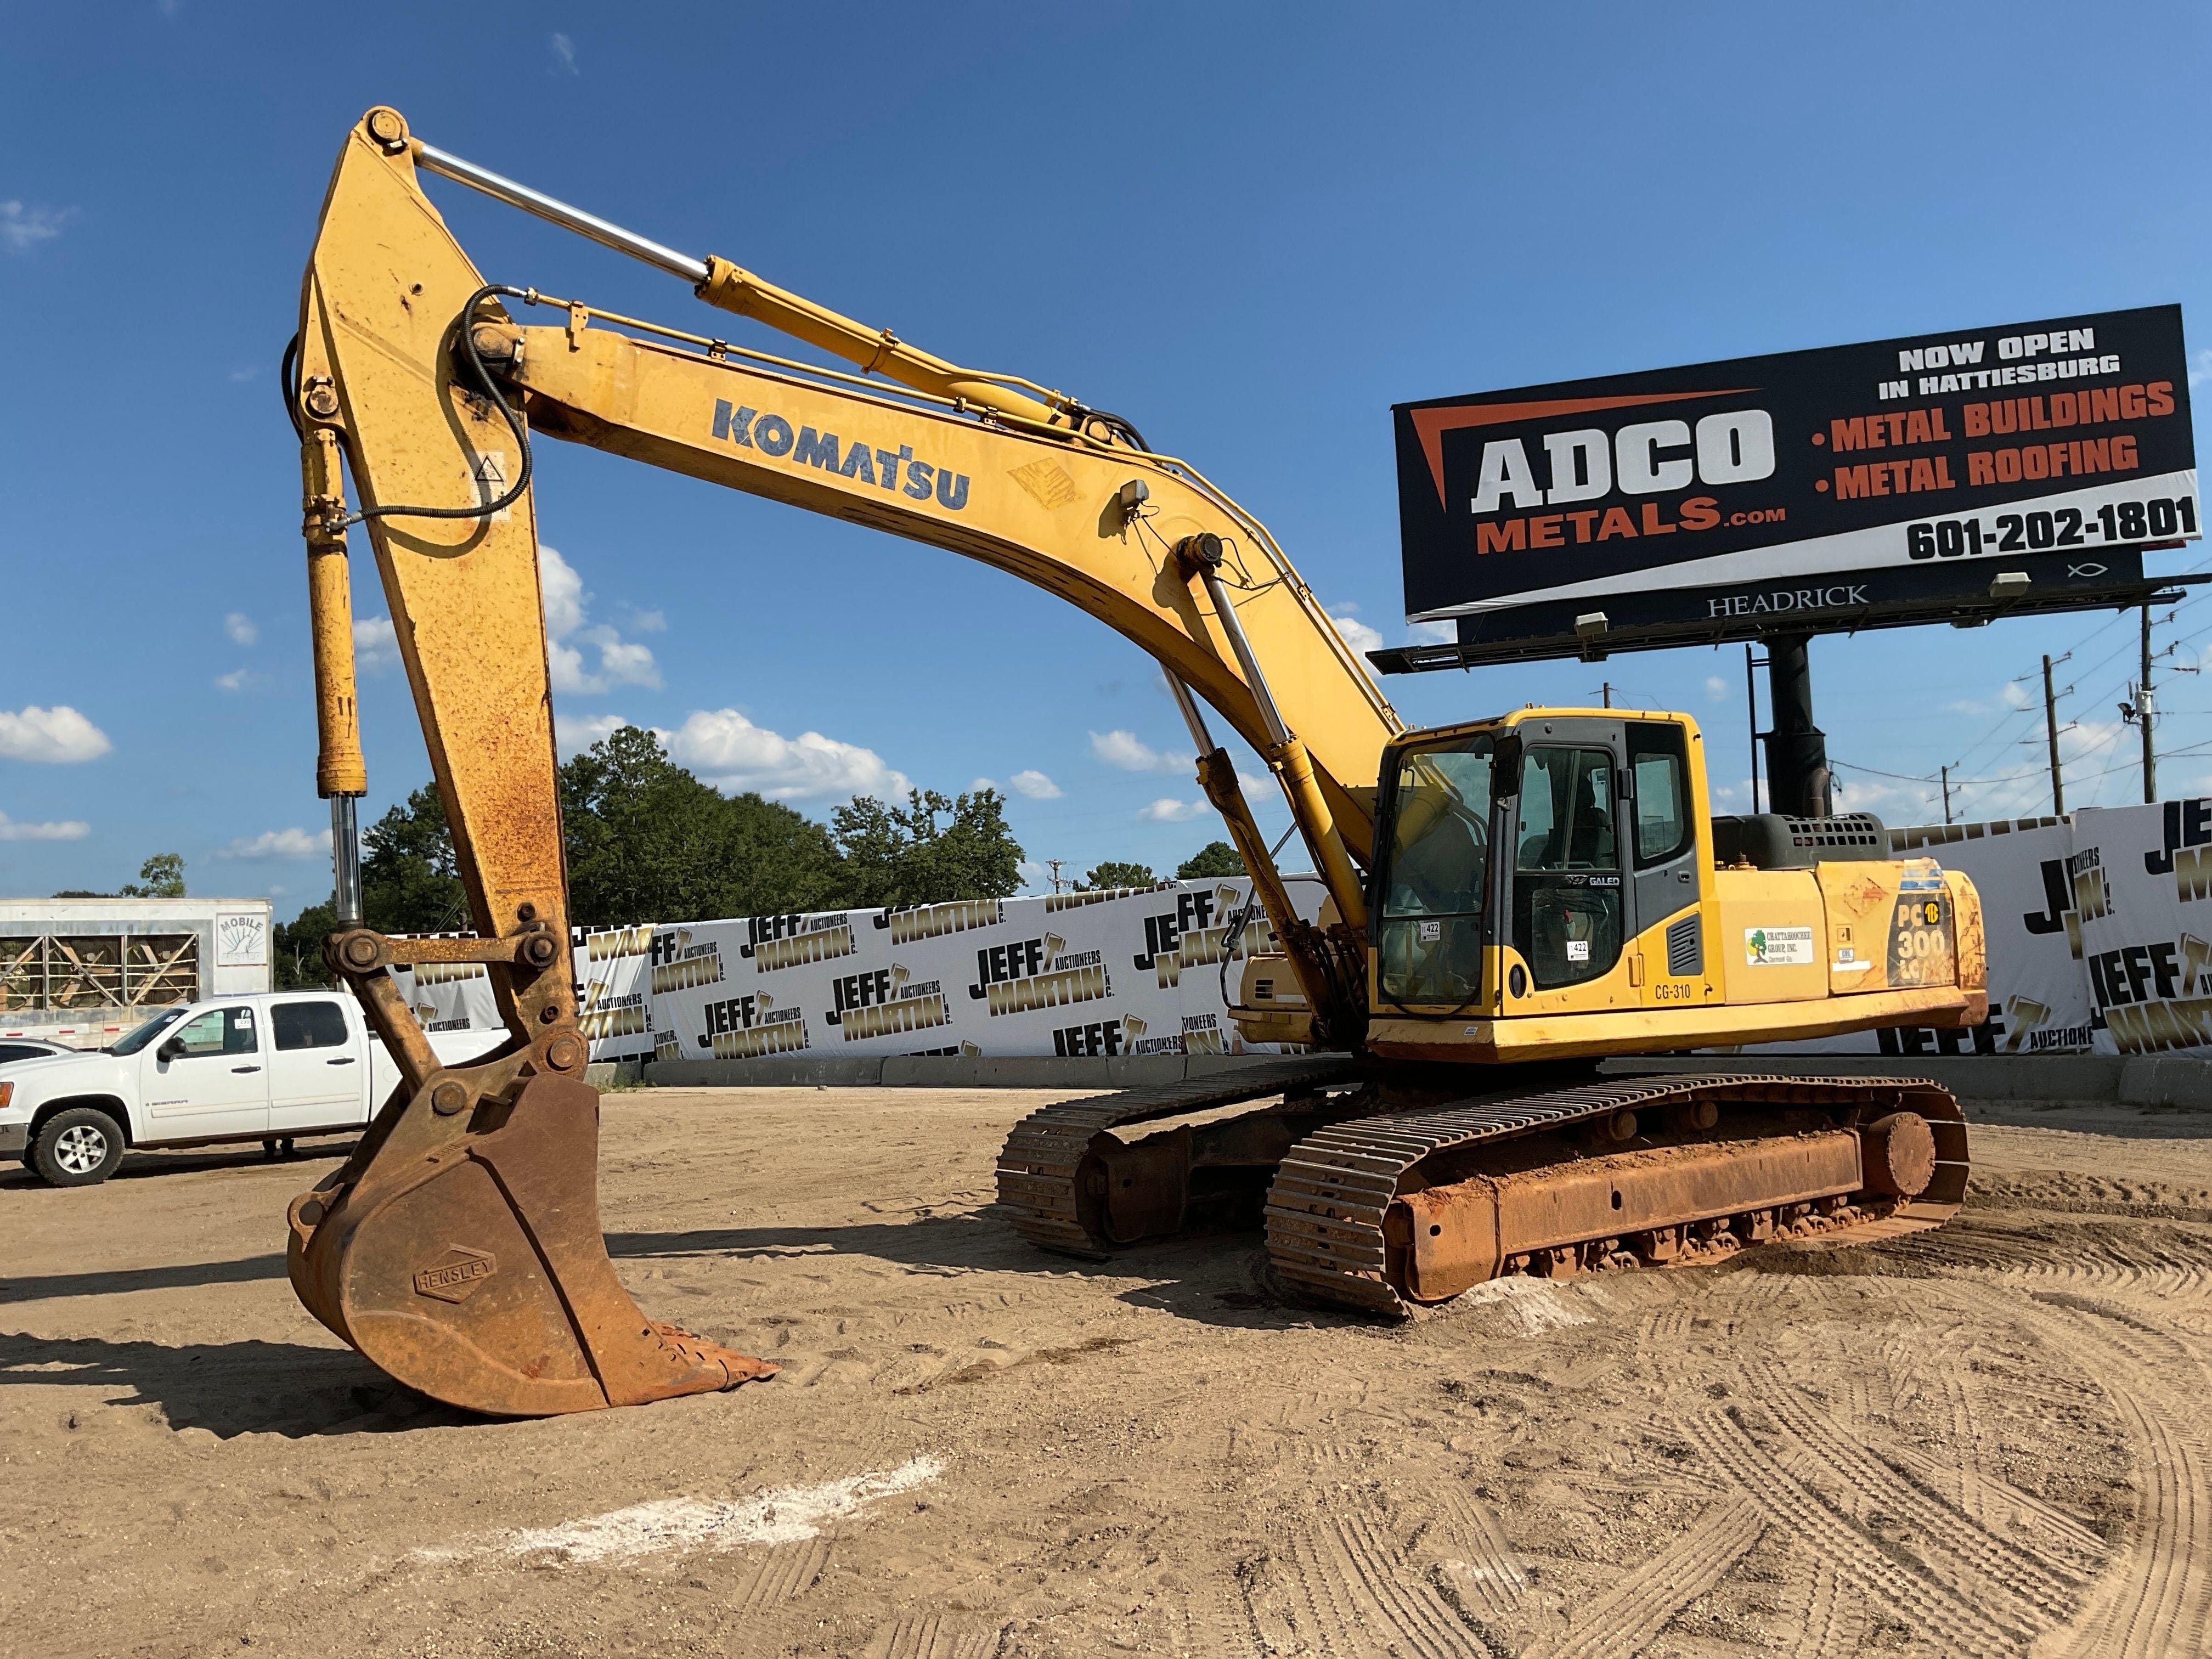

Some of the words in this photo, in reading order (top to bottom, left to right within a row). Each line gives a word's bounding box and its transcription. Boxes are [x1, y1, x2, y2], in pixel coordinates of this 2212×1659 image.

[1899, 341, 1985, 373] NOW
[1997, 328, 2095, 360] OPEN
[1878, 380, 1909, 400] IN
[1920, 354, 2120, 396] HATTIESBURG
[1831, 408, 1951, 453] METAL
[1963, 381, 2175, 437] BUILDINGS
[712, 398, 970, 510] KOMATSU
[1471, 409, 1775, 514] ADCO
[1835, 456, 1955, 500] METAL
[1967, 435, 2138, 486] ROOFING
[1908, 496, 2196, 561] 601-202-1801
[1707, 585, 1870, 617] HEADRICK
[1589, 877, 1620, 886] GALEO
[221, 917, 263, 932] MOBILE
[810, 912, 848, 932] AUCTIONEERS
[890, 899, 997, 945] MARTIN
[998, 899, 1006, 923] NC.
[1427, 924, 1438, 933] 422
[1898, 904, 1922, 927] PC
[684, 941, 717, 960] AUCTIONEERS
[740, 915, 802, 958] JEFF
[754, 926, 850, 974] MARTIN
[1574, 943, 1587, 952] 422
[1767, 931, 1811, 941] CHATTAHOOCHEE
[1898, 930, 1945, 958] 300
[652, 954, 719, 996] ARTIN
[968, 938, 1043, 1000] JEFF
[1055, 950, 1101, 971] AUCTIONEERS
[825, 968, 890, 1025] JEFF
[900, 980, 940, 1000] AUCTIONEERS
[987, 964, 1104, 1017] MARTIN
[1656, 984, 1690, 1000] CG-310
[2088, 941, 2180, 1030] JEFF
[428, 1018, 471, 1032] AUCTIONEERS
[697, 995, 755, 1048] JEFF
[765, 1006, 801, 1024] AUCTIONEERS
[842, 994, 944, 1042] MARTIN
[713, 1020, 804, 1060] MARTIN
[417, 1260, 489, 1290] HENSLEY
